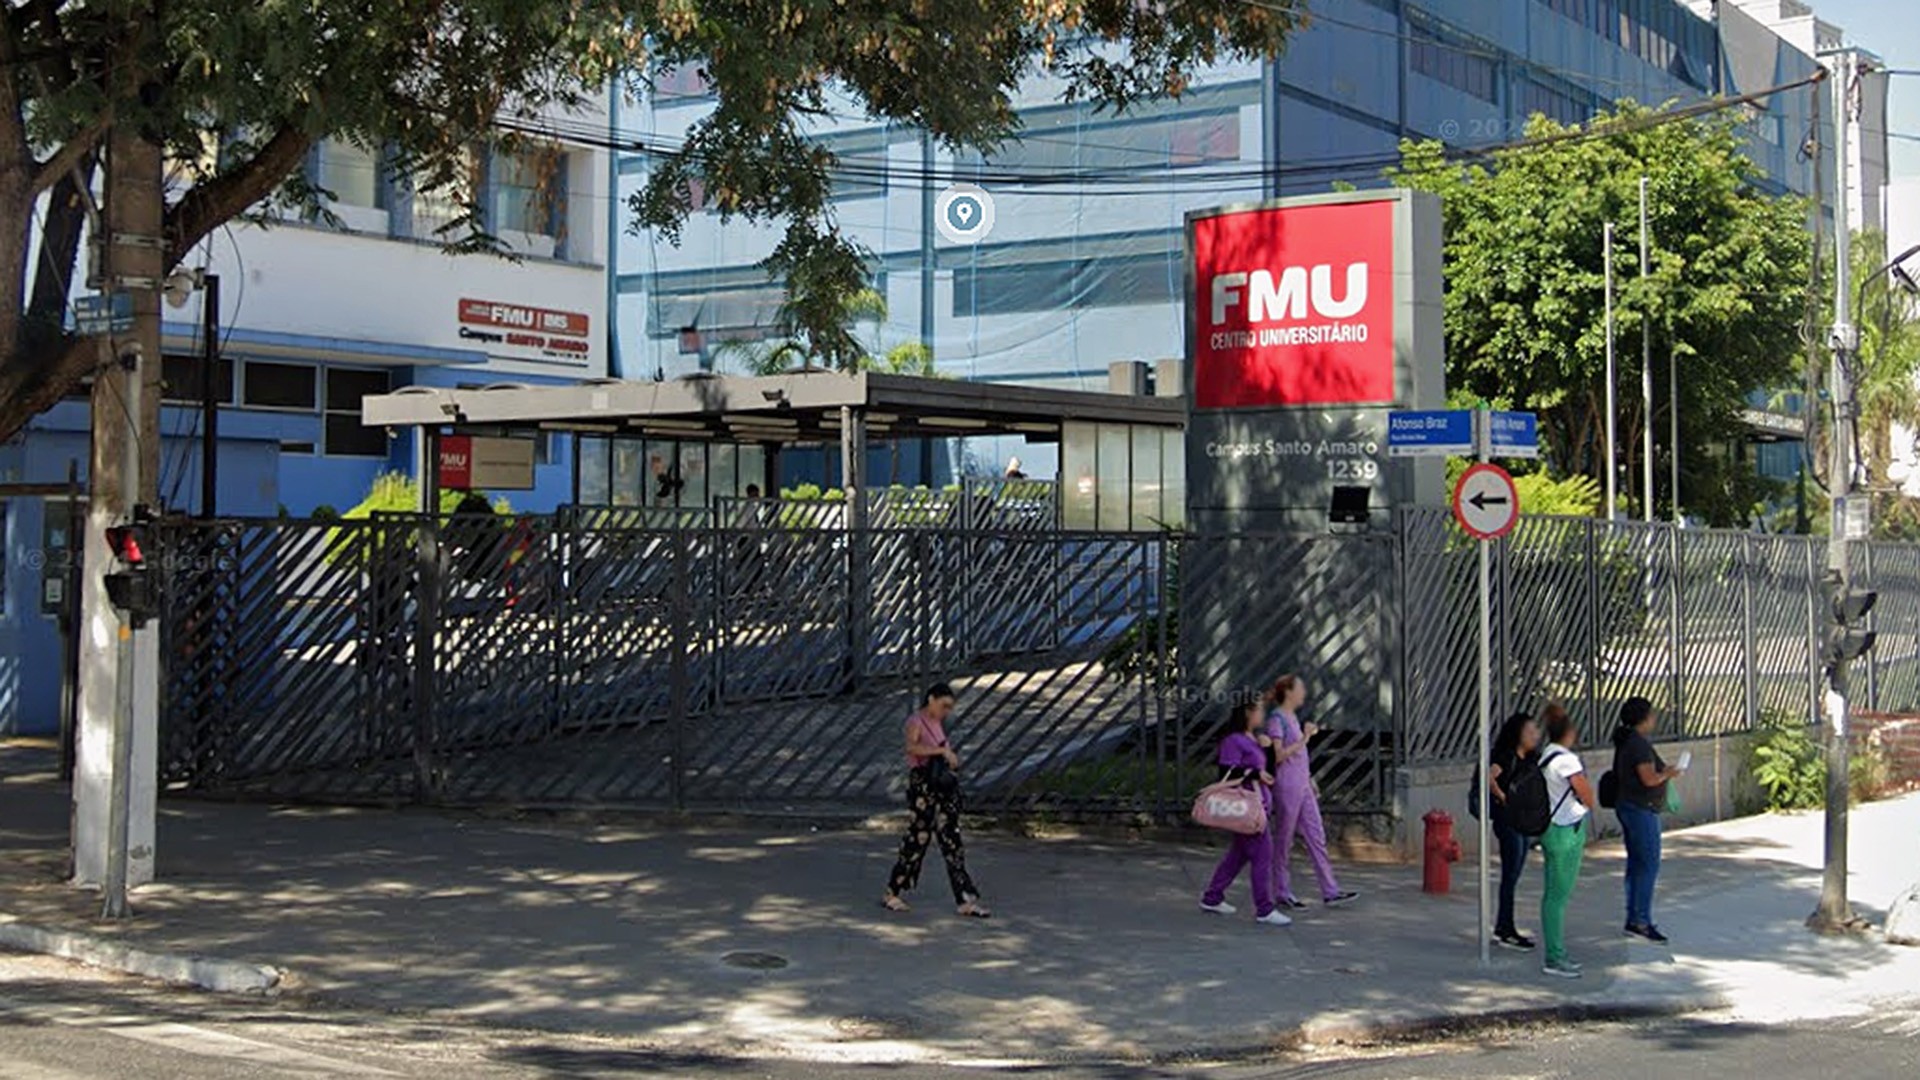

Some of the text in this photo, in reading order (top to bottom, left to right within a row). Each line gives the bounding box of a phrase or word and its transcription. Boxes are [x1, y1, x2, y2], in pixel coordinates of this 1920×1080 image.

[1211, 262, 1368, 325] FMU
[490, 305, 534, 326] FMU
[1211, 321, 1368, 350] CENTRO UNIVERSITÁRIO
[1391, 416, 1449, 430] Afonso Braz
[1205, 440, 1378, 459] Campus Santo Amaro
[1326, 459, 1379, 479] 1239
